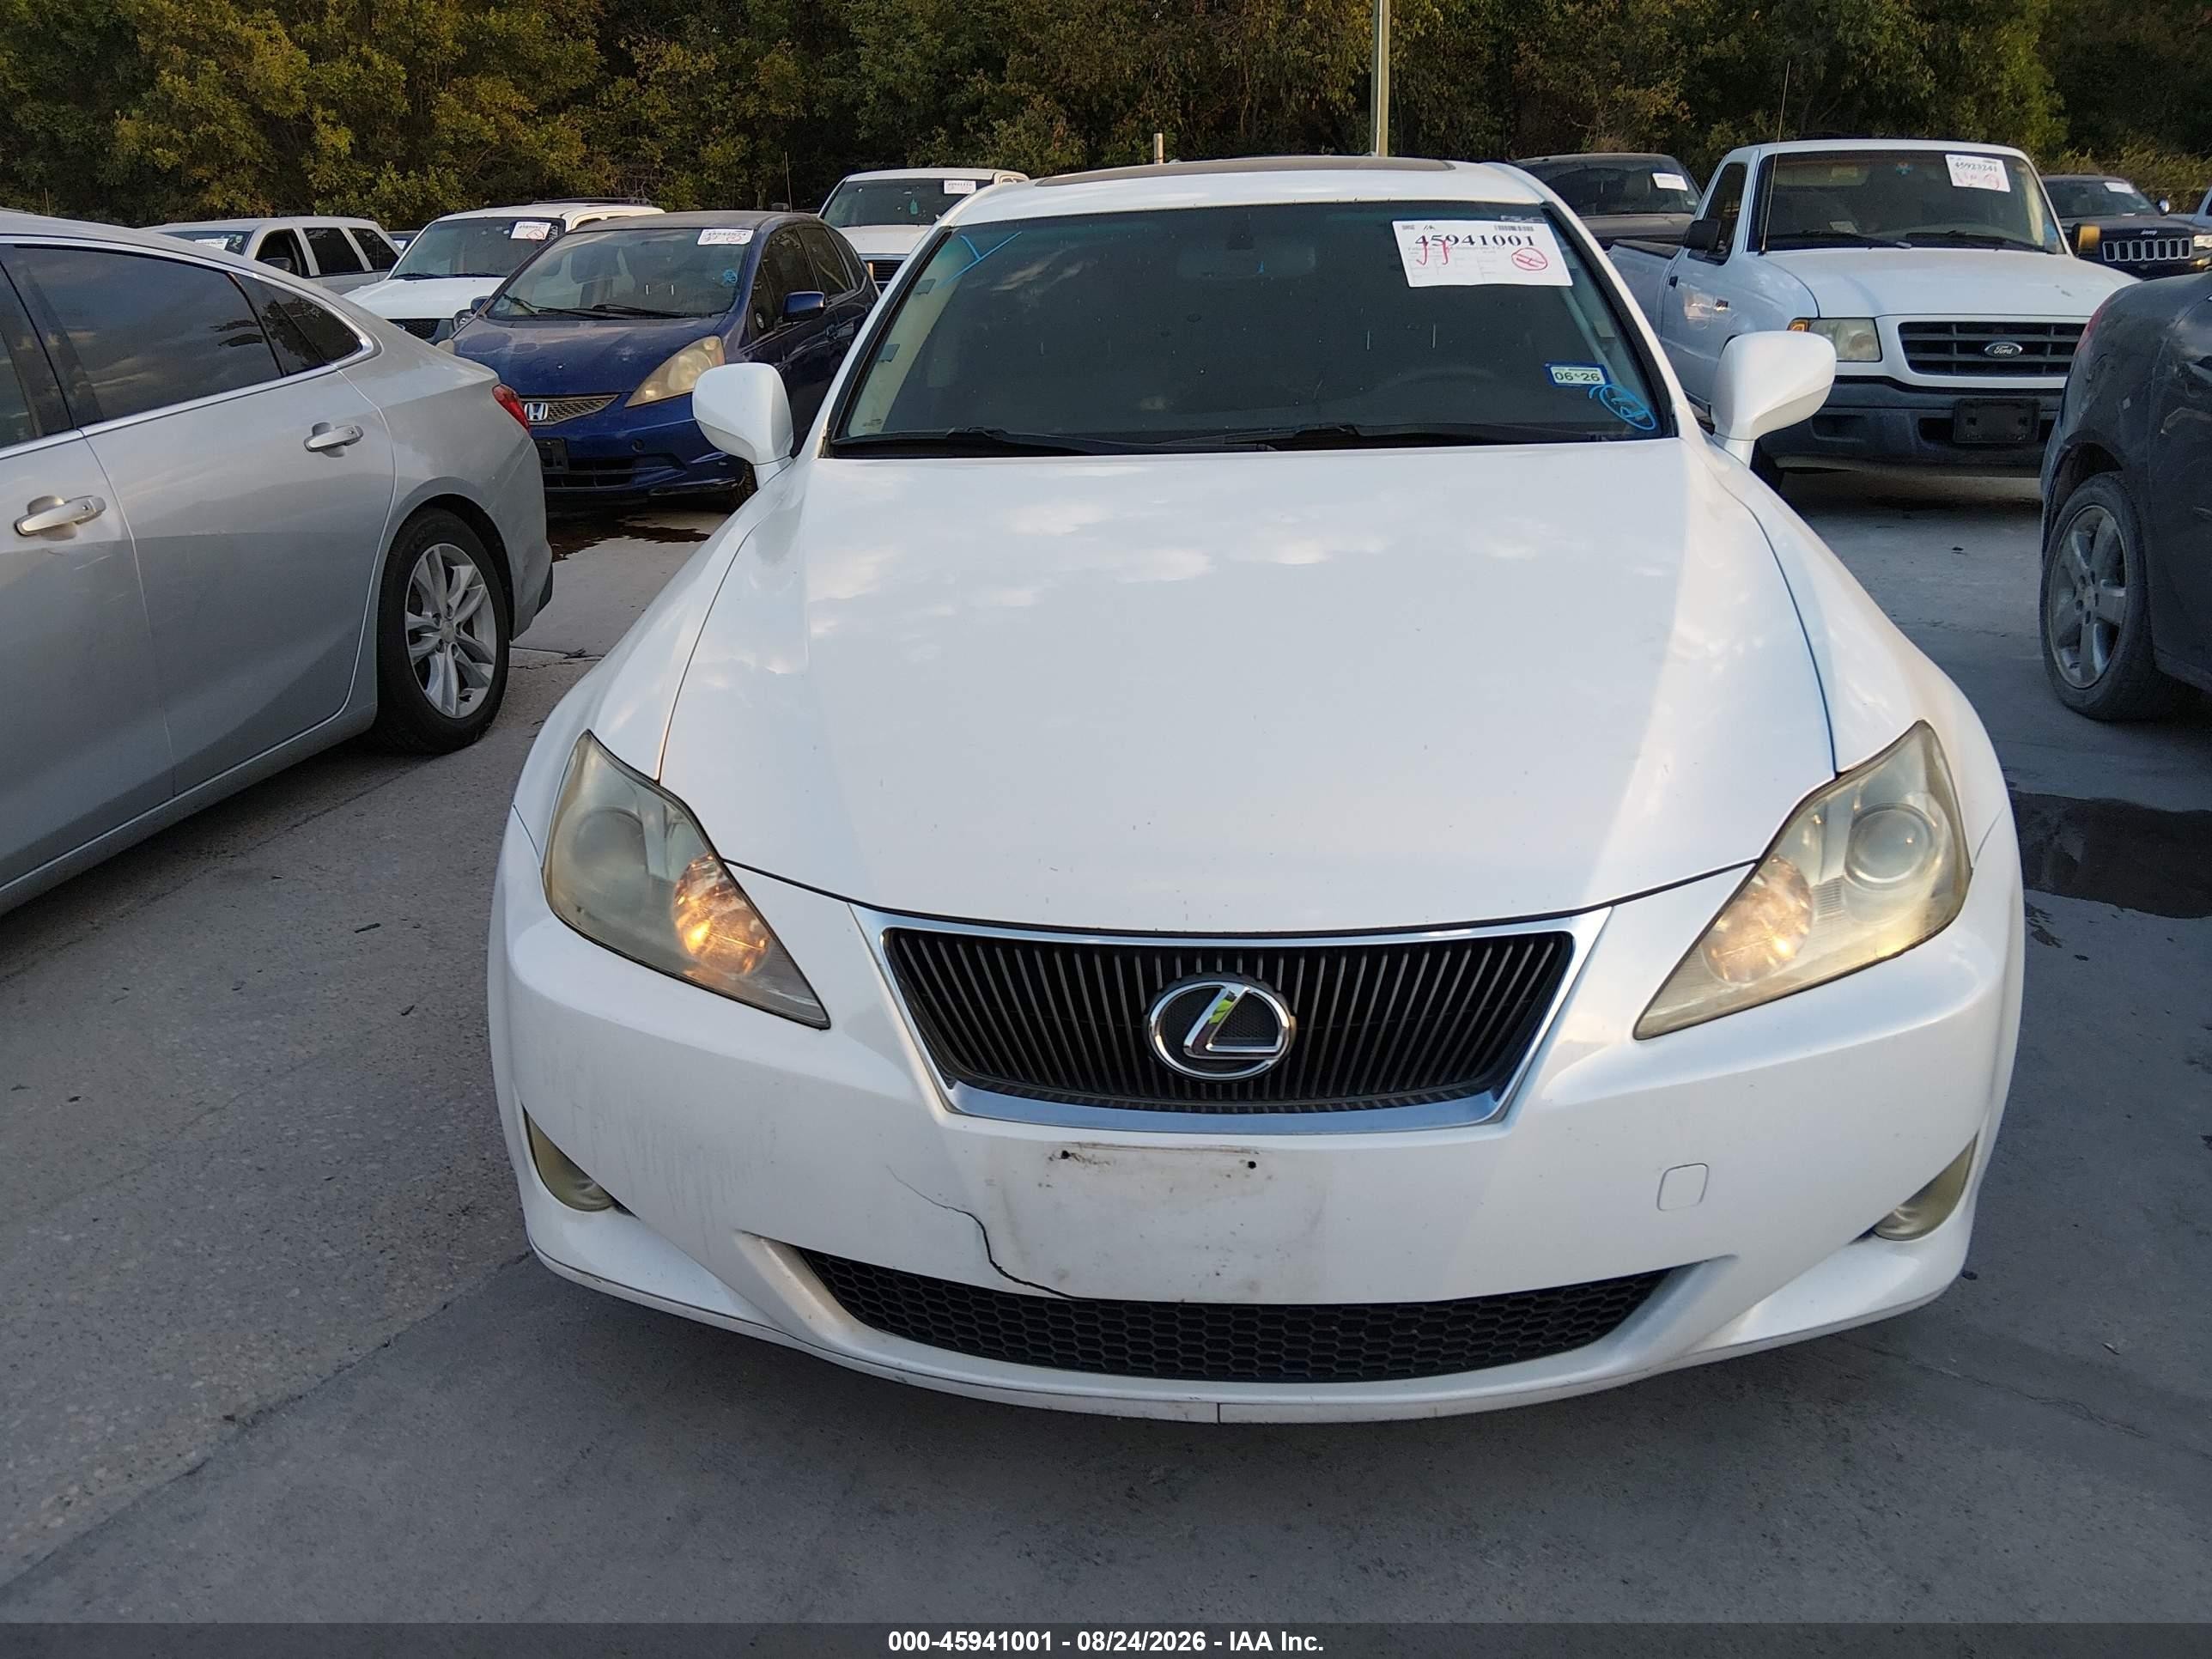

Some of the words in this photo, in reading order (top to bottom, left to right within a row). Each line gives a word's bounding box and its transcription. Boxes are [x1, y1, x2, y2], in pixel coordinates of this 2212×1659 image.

[1415, 234, 1536, 247] 45941001
[1993, 345, 2014, 355] Ford
[1554, 371, 1574, 381] 06
[1580, 372, 1601, 382] 26
